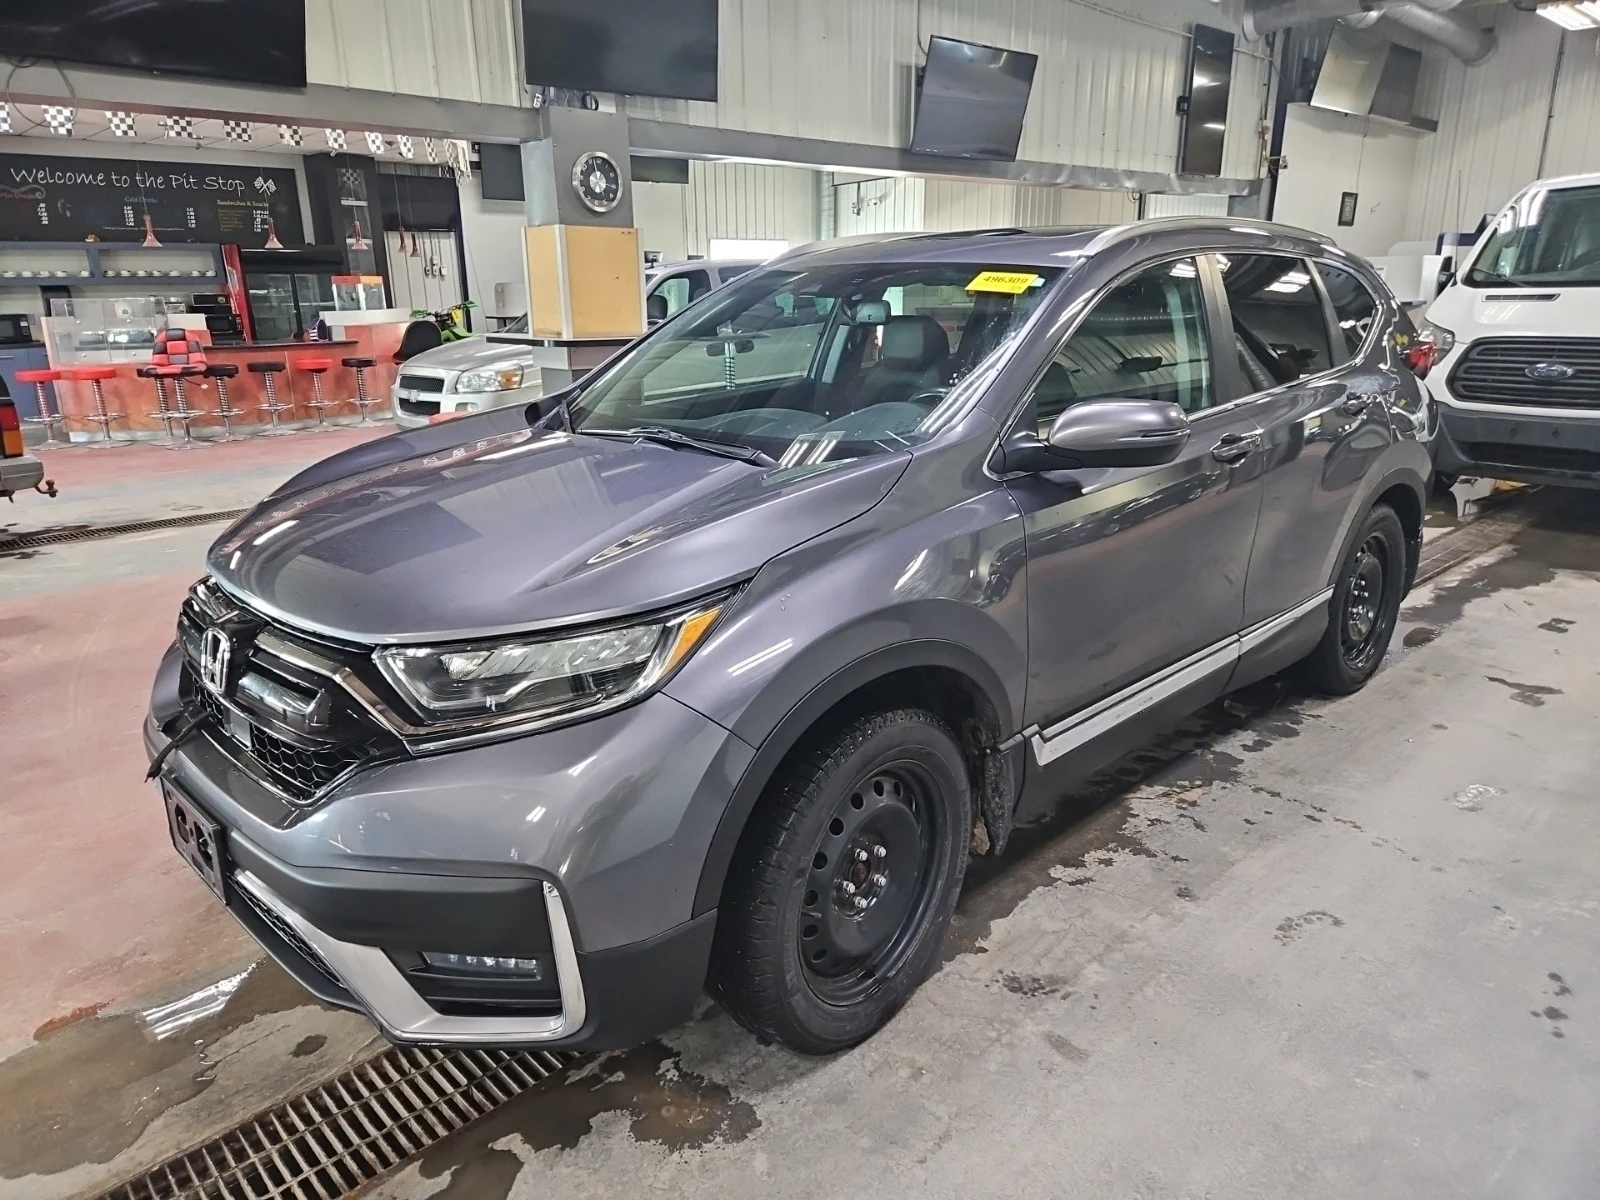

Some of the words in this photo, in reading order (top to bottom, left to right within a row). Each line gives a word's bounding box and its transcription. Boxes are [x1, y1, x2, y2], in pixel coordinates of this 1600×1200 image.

[10, 166, 106, 185] Welcome
[111, 172, 130, 188] to
[135, 172, 166, 190] the
[169, 172, 198, 190] Pit
[203, 175, 245, 198] Stop
[983, 276, 1029, 284] 496309
